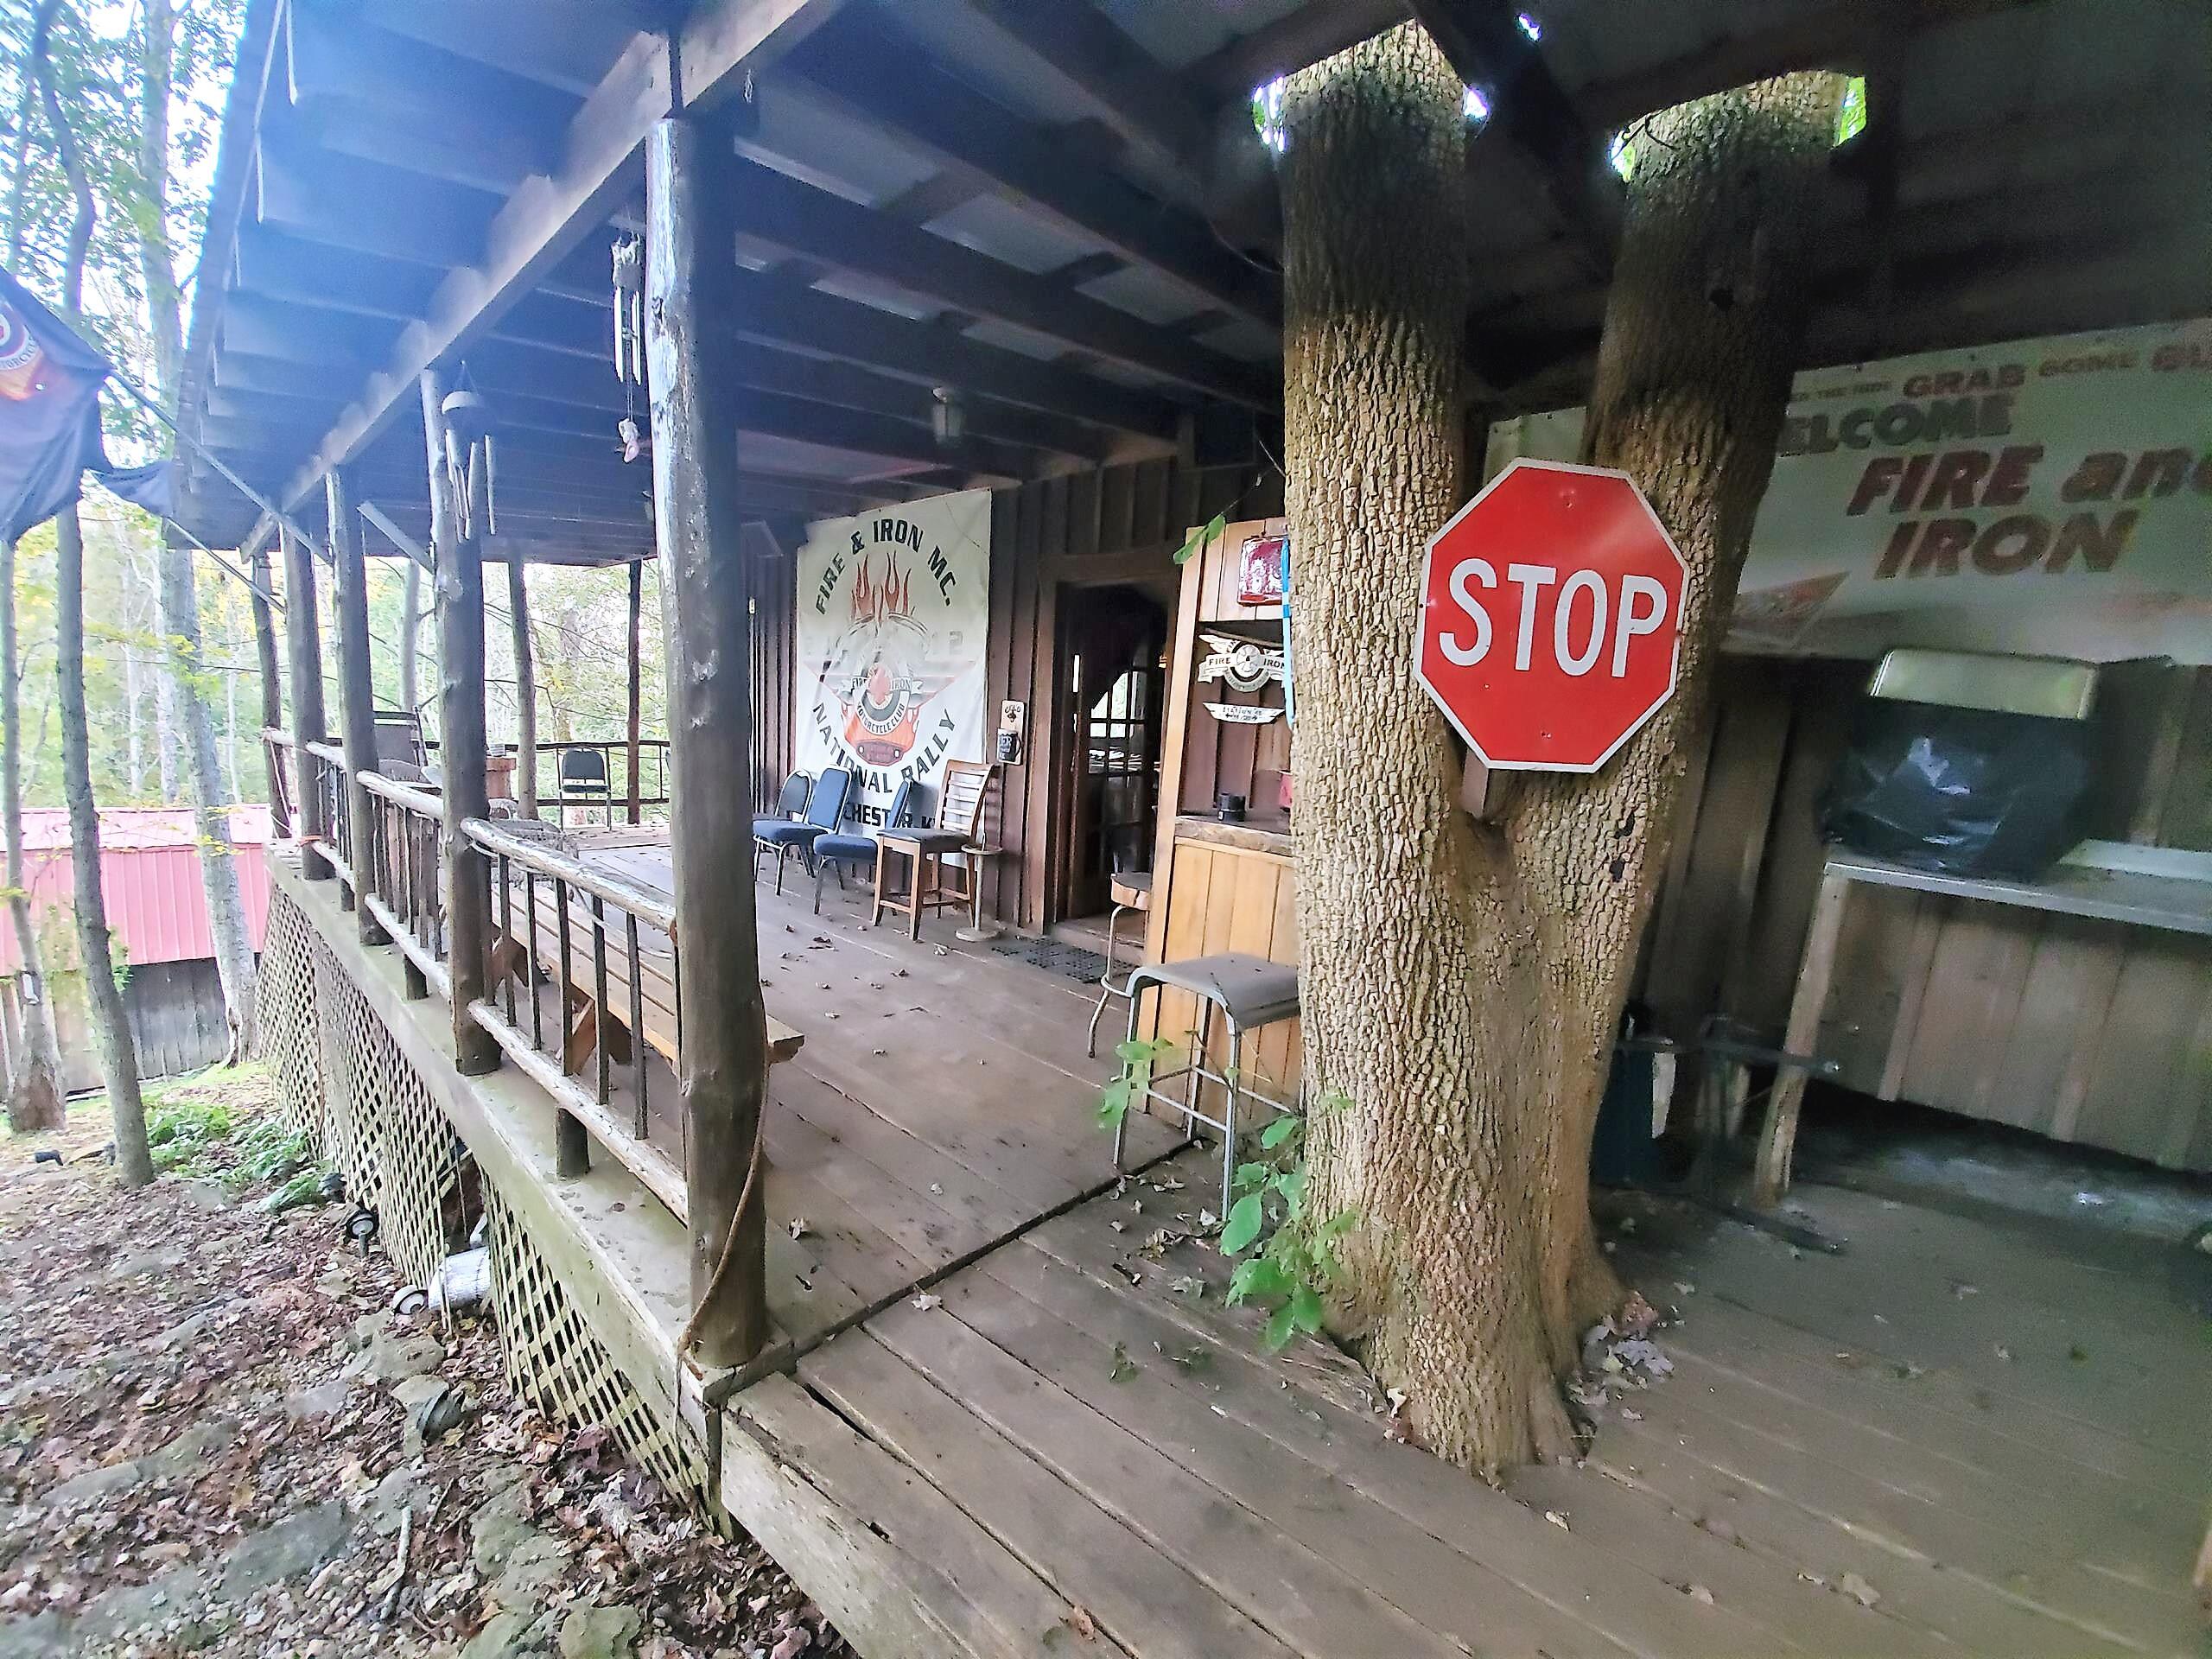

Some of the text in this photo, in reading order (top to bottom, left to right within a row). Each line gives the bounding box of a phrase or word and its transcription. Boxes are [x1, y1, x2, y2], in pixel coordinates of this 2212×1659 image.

[1904, 364, 2026, 397] GRAB
[1778, 394, 2015, 458] ELCOME
[1846, 445, 2044, 517] FIRE
[816, 552, 846, 615] FIRE
[850, 531, 865, 555] &
[873, 518, 924, 553] IRON
[1873, 508, 2140, 581] IRON
[1439, 557, 1668, 678] STOP
[1209, 657, 1231, 666] FIRE
[813, 702, 956, 793] NATIONAL RALLY
